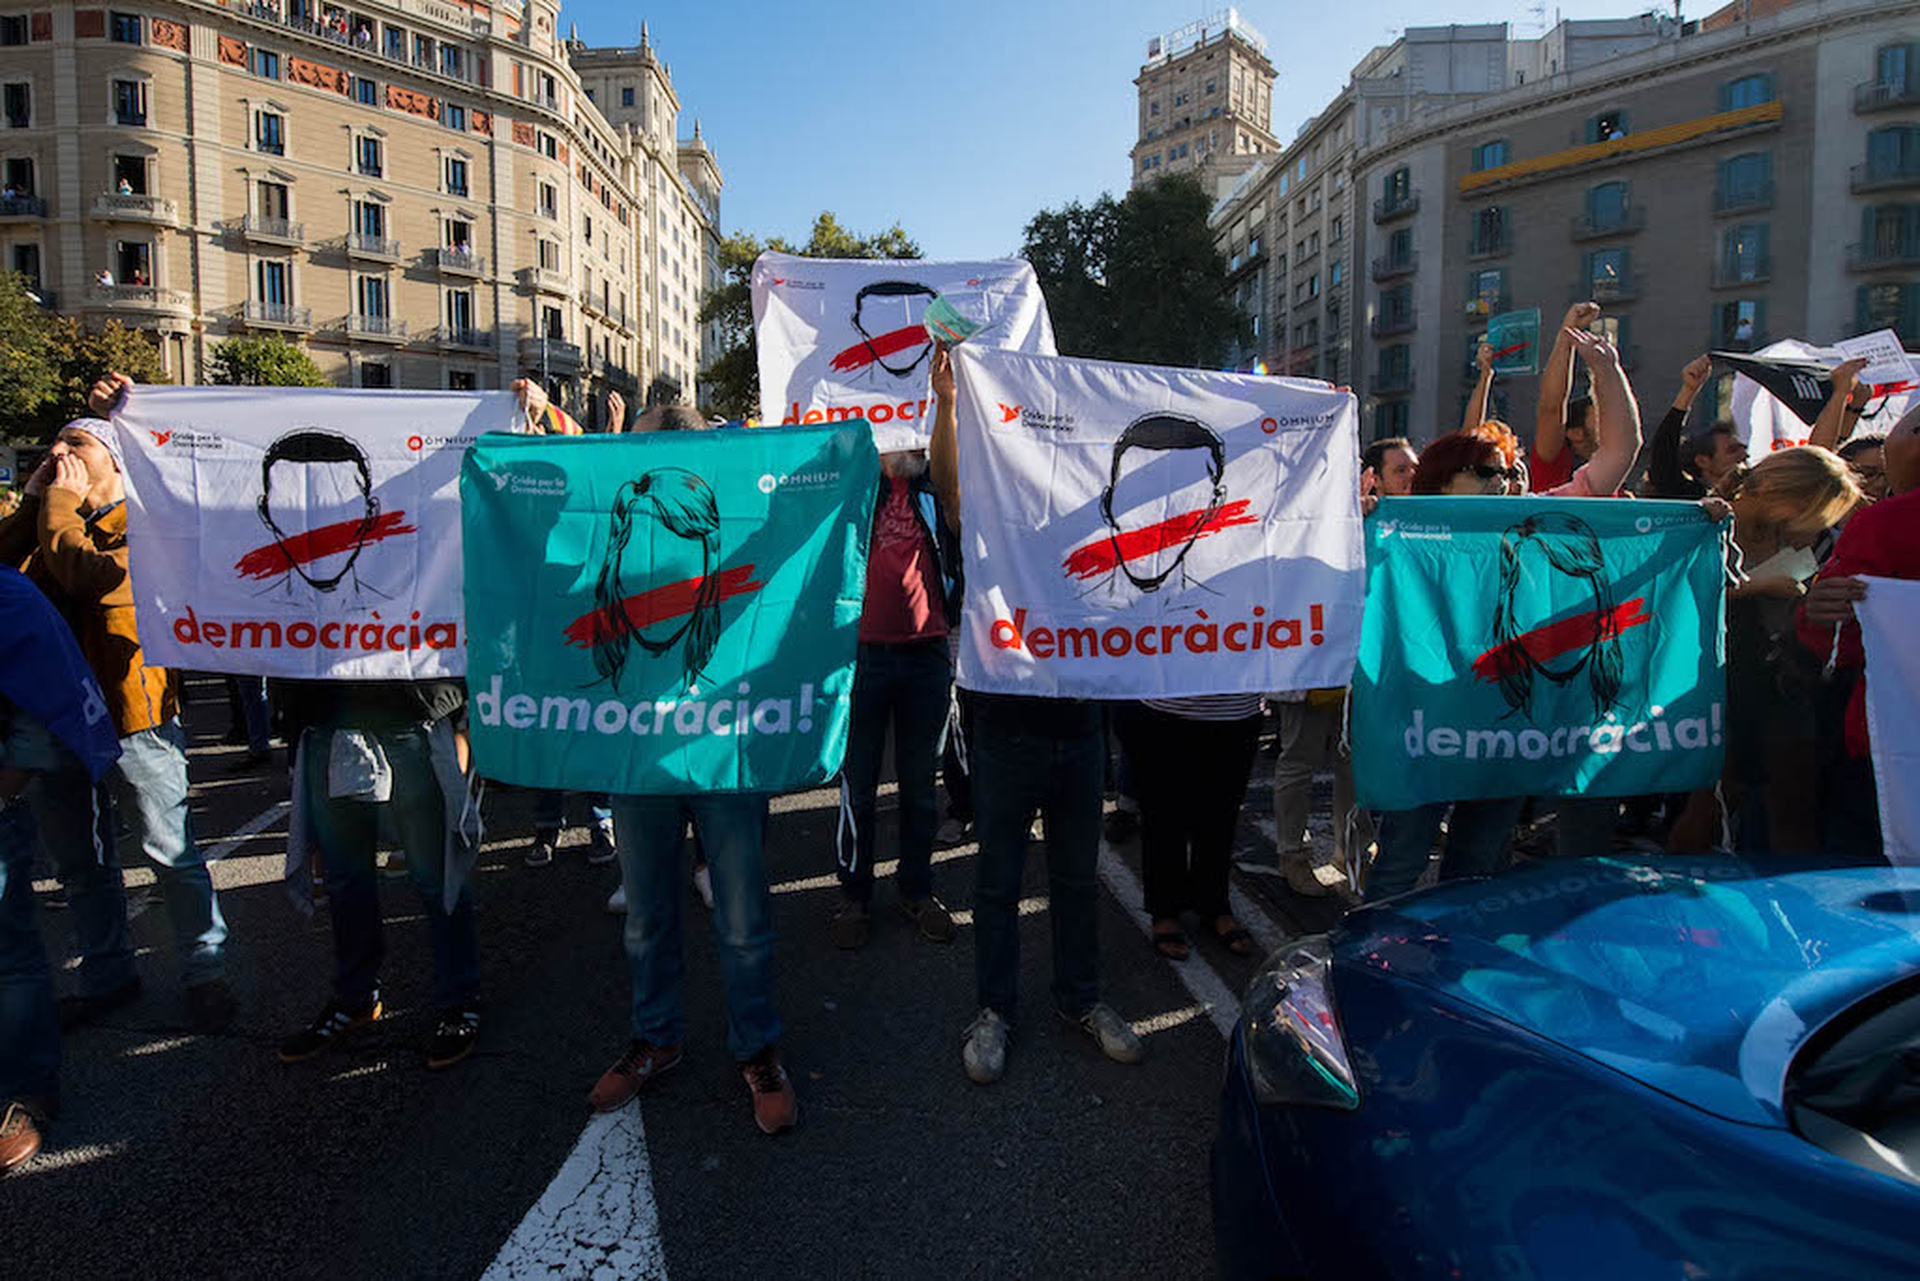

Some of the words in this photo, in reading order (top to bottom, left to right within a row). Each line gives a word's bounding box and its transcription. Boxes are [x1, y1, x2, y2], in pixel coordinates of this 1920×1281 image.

[781, 397, 935, 424] democr
[173, 604, 468, 651] democràcia
[990, 603, 1324, 659] democràcia!
[476, 675, 814, 736] democràcia!
[1404, 703, 1722, 760] democràcia!
